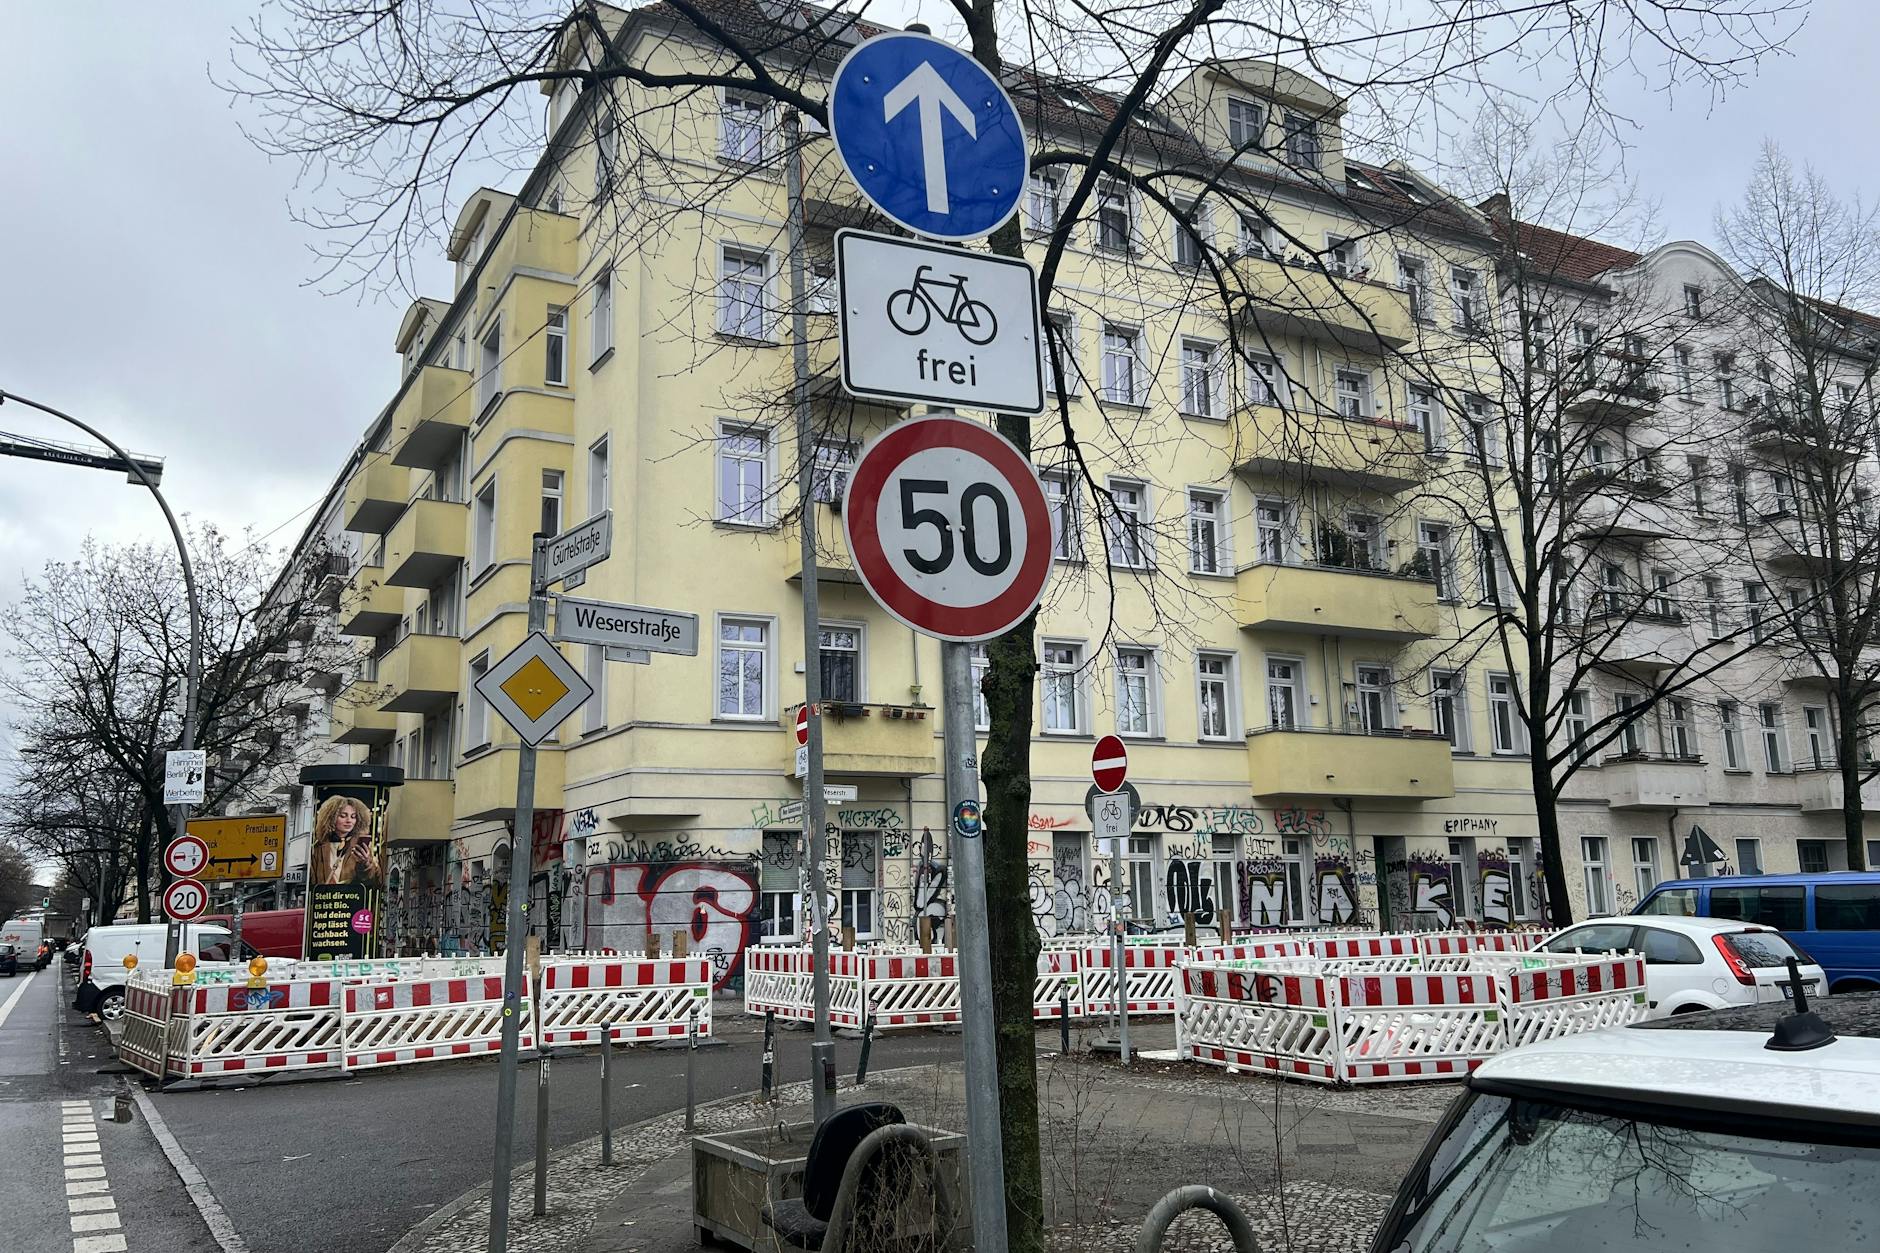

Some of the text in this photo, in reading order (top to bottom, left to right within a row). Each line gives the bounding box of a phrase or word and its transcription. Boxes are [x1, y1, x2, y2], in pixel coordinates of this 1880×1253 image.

[917, 348, 977, 387] frei
[900, 478, 1012, 578] 50
[553, 527, 601, 567] Gürtelstraße
[576, 607, 681, 643] Weserstraße
[189, 752, 204, 760] Der
[166, 770, 188, 778] Berlin
[165, 789, 203, 798] Werbefrei
[245, 823, 279, 833] Prenzlauer
[1105, 823, 1119, 833] frei
[1445, 818, 1498, 835] EPIPHANY
[264, 836, 279, 848] Berg
[286, 872, 301, 881] BAR
[173, 891, 197, 911] 20
[315, 892, 360, 900] Stell dir vor,
[333, 901, 350, 909] Bio.
[313, 910, 352, 919] Und deine
[313, 920, 327, 930] App
[327, 920, 348, 929] lässt
[312, 929, 349, 938] Cashback
[312, 939, 348, 948] wachsen.
